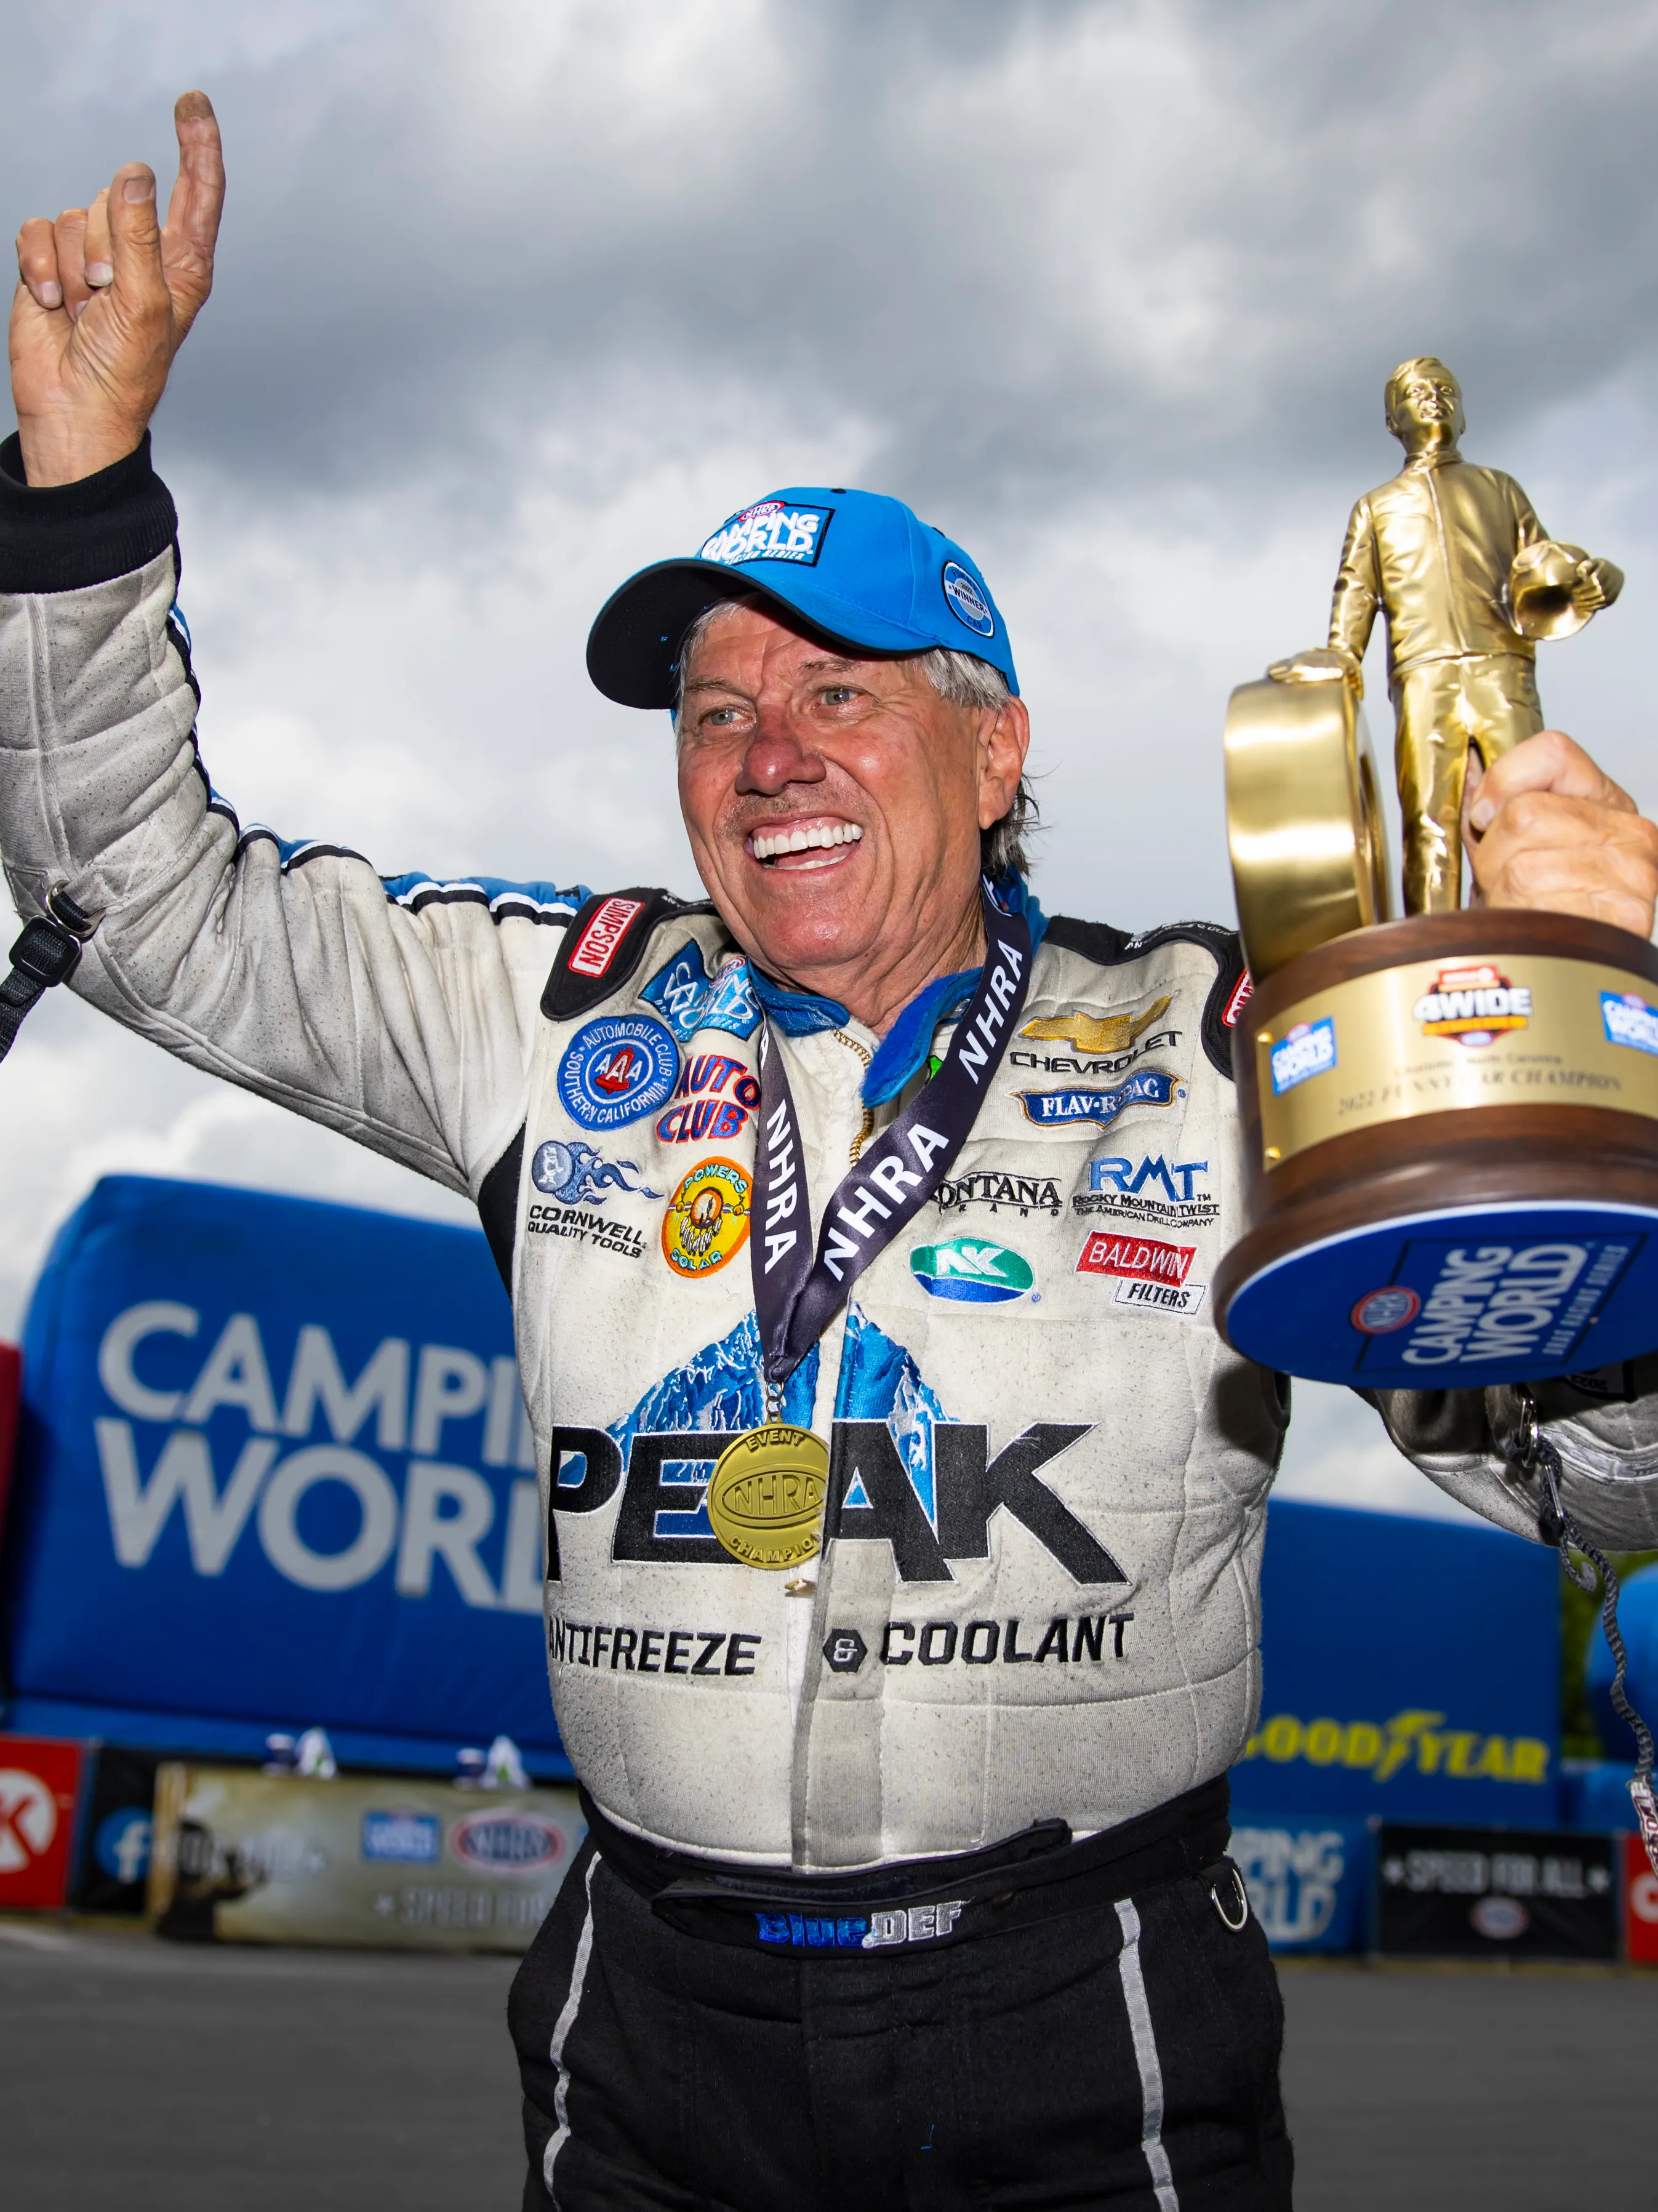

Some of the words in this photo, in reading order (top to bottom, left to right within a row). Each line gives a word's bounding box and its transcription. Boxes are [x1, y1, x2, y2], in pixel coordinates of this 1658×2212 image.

[952, 584, 986, 614] WINNER
[967, 615, 984, 631] CAR
[579, 899, 636, 967] SIMPSON
[958, 939, 1023, 1085] NHRA
[1414, 987, 1532, 1022] 4WIDE
[582, 1022, 663, 1050] AUTOMOBILE
[655, 1043, 673, 1077] CLUB
[595, 1053, 643, 1083] AAA
[1010, 1030, 1183, 1074] CHEVROLET
[564, 1051, 598, 1122] SOUTHERN
[597, 1081, 668, 1124] CALIFORNIA
[675, 1054, 761, 1108] AUTO
[1510, 1068, 1623, 1092] CHAMPION
[656, 1099, 750, 1144] CLUB
[684, 1163, 749, 1194] POWERS
[764, 1099, 799, 1275] NHRA
[932, 1174, 1063, 1210] ONTANA
[1089, 1153, 1209, 1202] RMT
[529, 1204, 643, 1245] CORNWELL
[823, 1123, 950, 1282] NHRA
[1072, 1193, 1119, 1207] ROCKY
[1120, 1193, 1177, 1217] MOUNTAIN
[1177, 1204, 1220, 1217] TWIST
[1074, 1205, 1094, 1216] THE
[1096, 1204, 1146, 1222] AMERICAN
[1147, 1212, 1170, 1226] DRILL
[1169, 1217, 1215, 1229] COMPANY
[527, 1221, 588, 1241] QUALITY
[591, 1233, 643, 1259] TOOLS
[670, 1248, 723, 1270] SOLAR
[1089, 1241, 1189, 1280] BALDWIN
[1127, 1283, 1191, 1308] FILTERS
[1401, 1246, 1513, 1365] CAMPING
[1459, 1243, 1588, 1363] WORLD
[97, 1300, 537, 1470] CAMPI
[746, 1429, 804, 1452] EVENT
[94, 1417, 543, 1615] WORL
[547, 1421, 1131, 1587] PEAK
[734, 1473, 820, 1516] NHRA
[879, 1612, 1135, 1665] COOLANT
[1245, 1709, 1549, 1783] OODYEAR
[1227, 1827, 1344, 1886] PING
